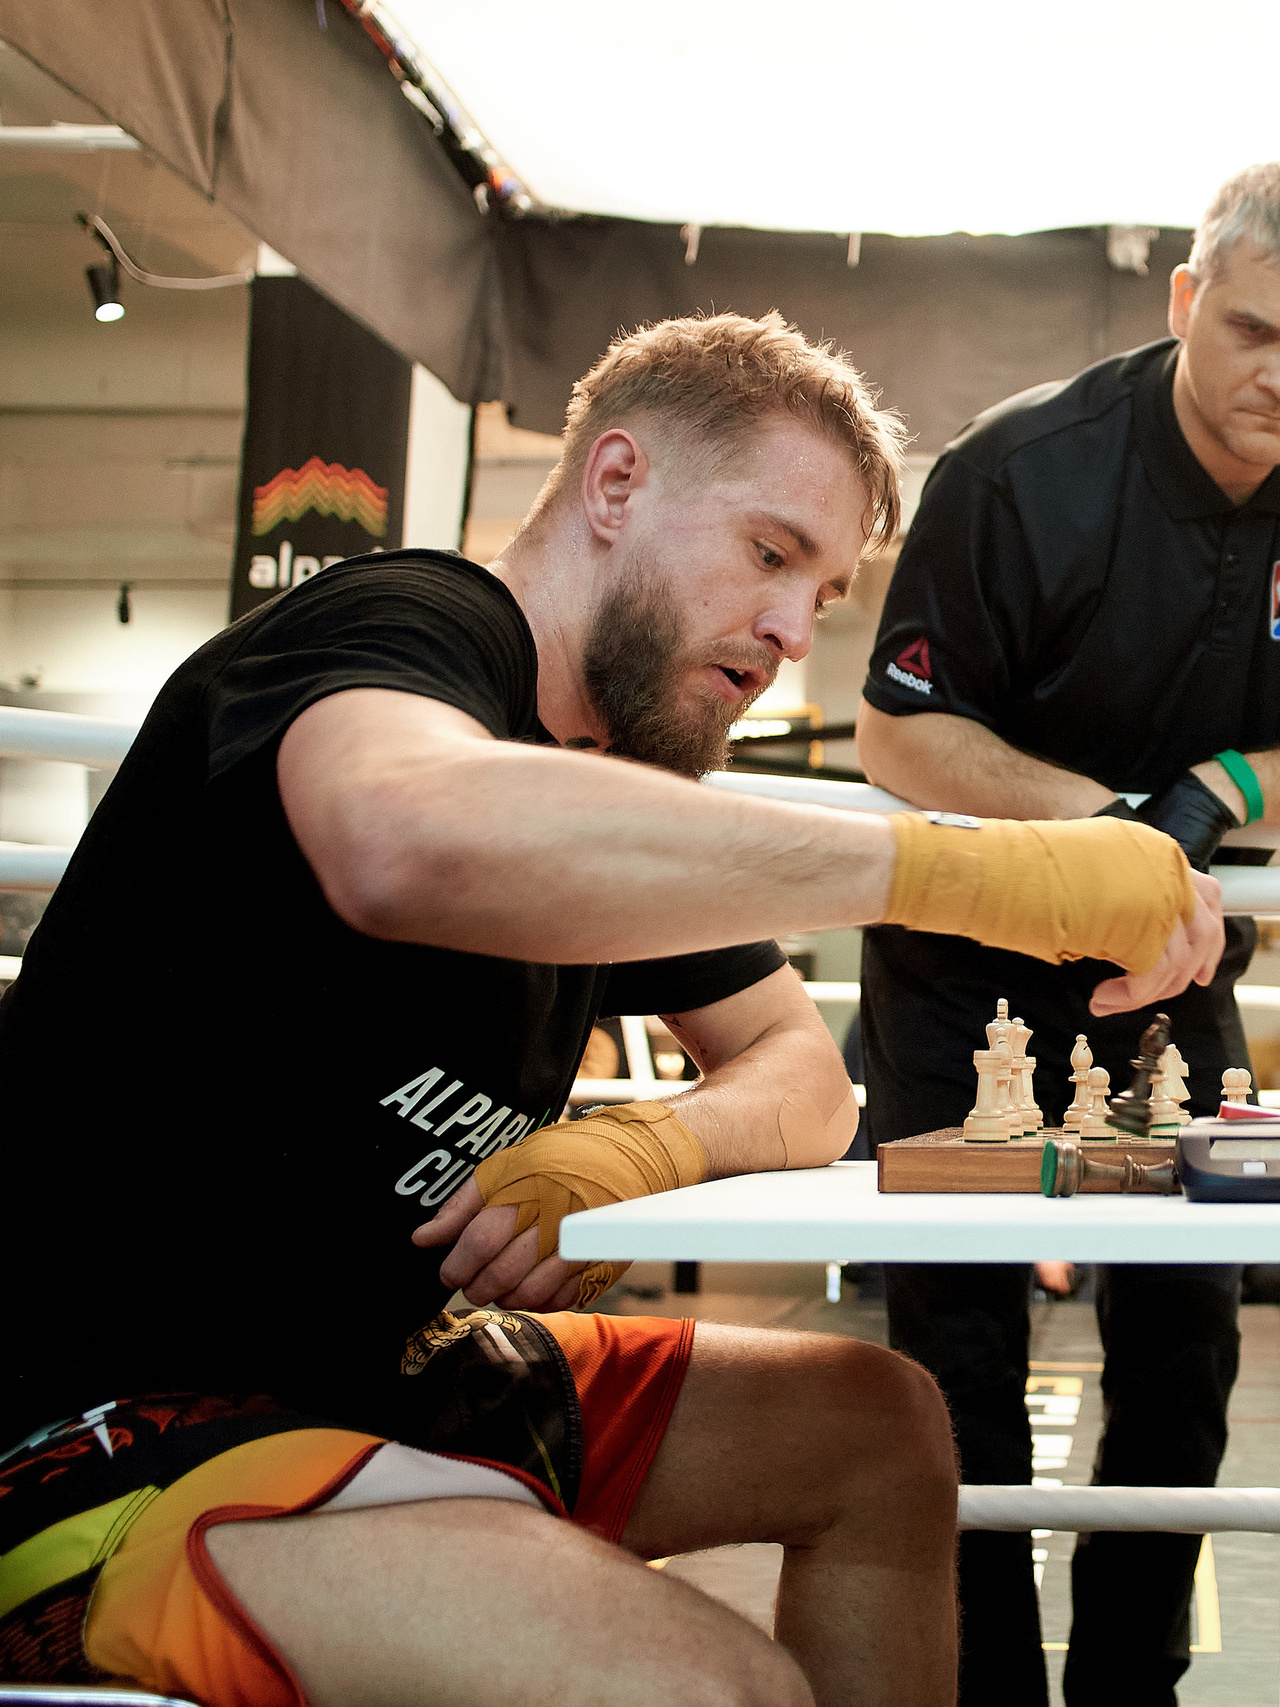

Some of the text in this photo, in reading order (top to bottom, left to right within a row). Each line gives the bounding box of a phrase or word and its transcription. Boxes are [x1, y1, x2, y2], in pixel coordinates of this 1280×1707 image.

[248, 540, 384, 588] alp
[886, 662, 933, 695] Reebok
[394, 1148, 476, 1207] CU
